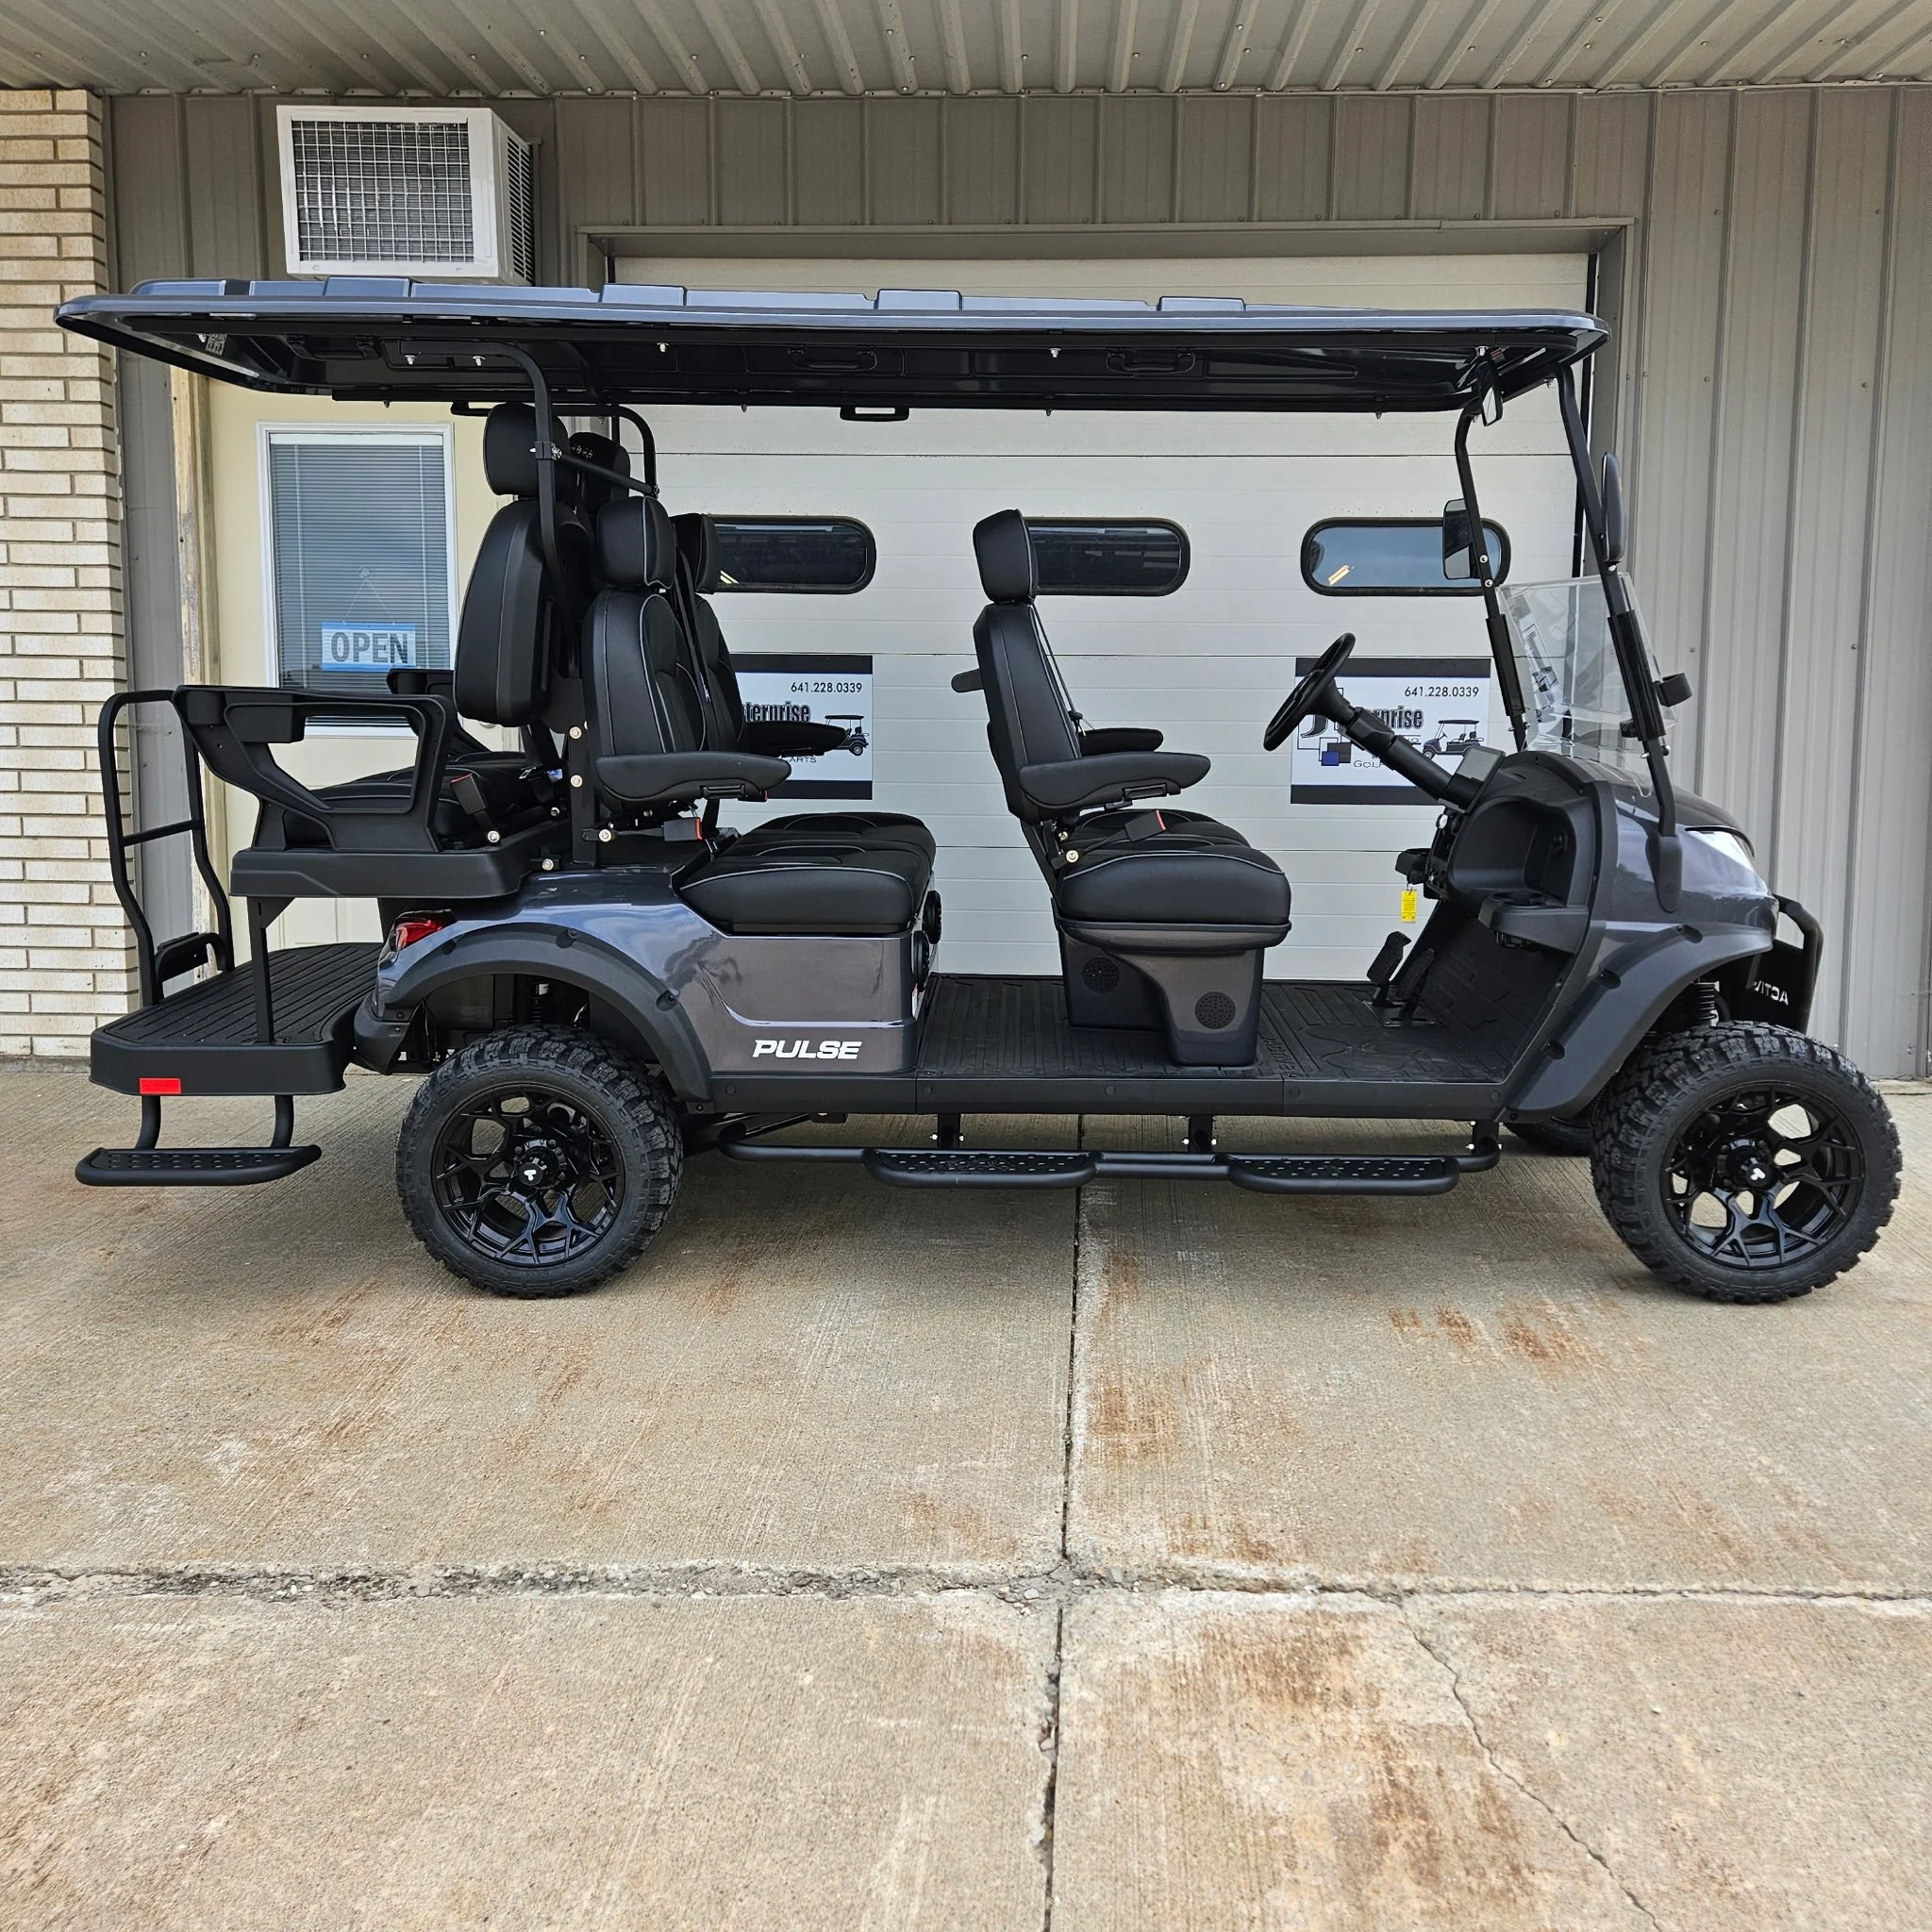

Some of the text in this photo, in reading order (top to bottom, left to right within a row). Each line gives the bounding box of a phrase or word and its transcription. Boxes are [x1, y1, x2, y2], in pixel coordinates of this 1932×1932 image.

[331, 631, 408, 664] OPEN
[791, 682, 863, 693] 641.228.0339
[1404, 686, 1479, 697] 641.228.0339
[752, 1040, 863, 1059] PULSE
